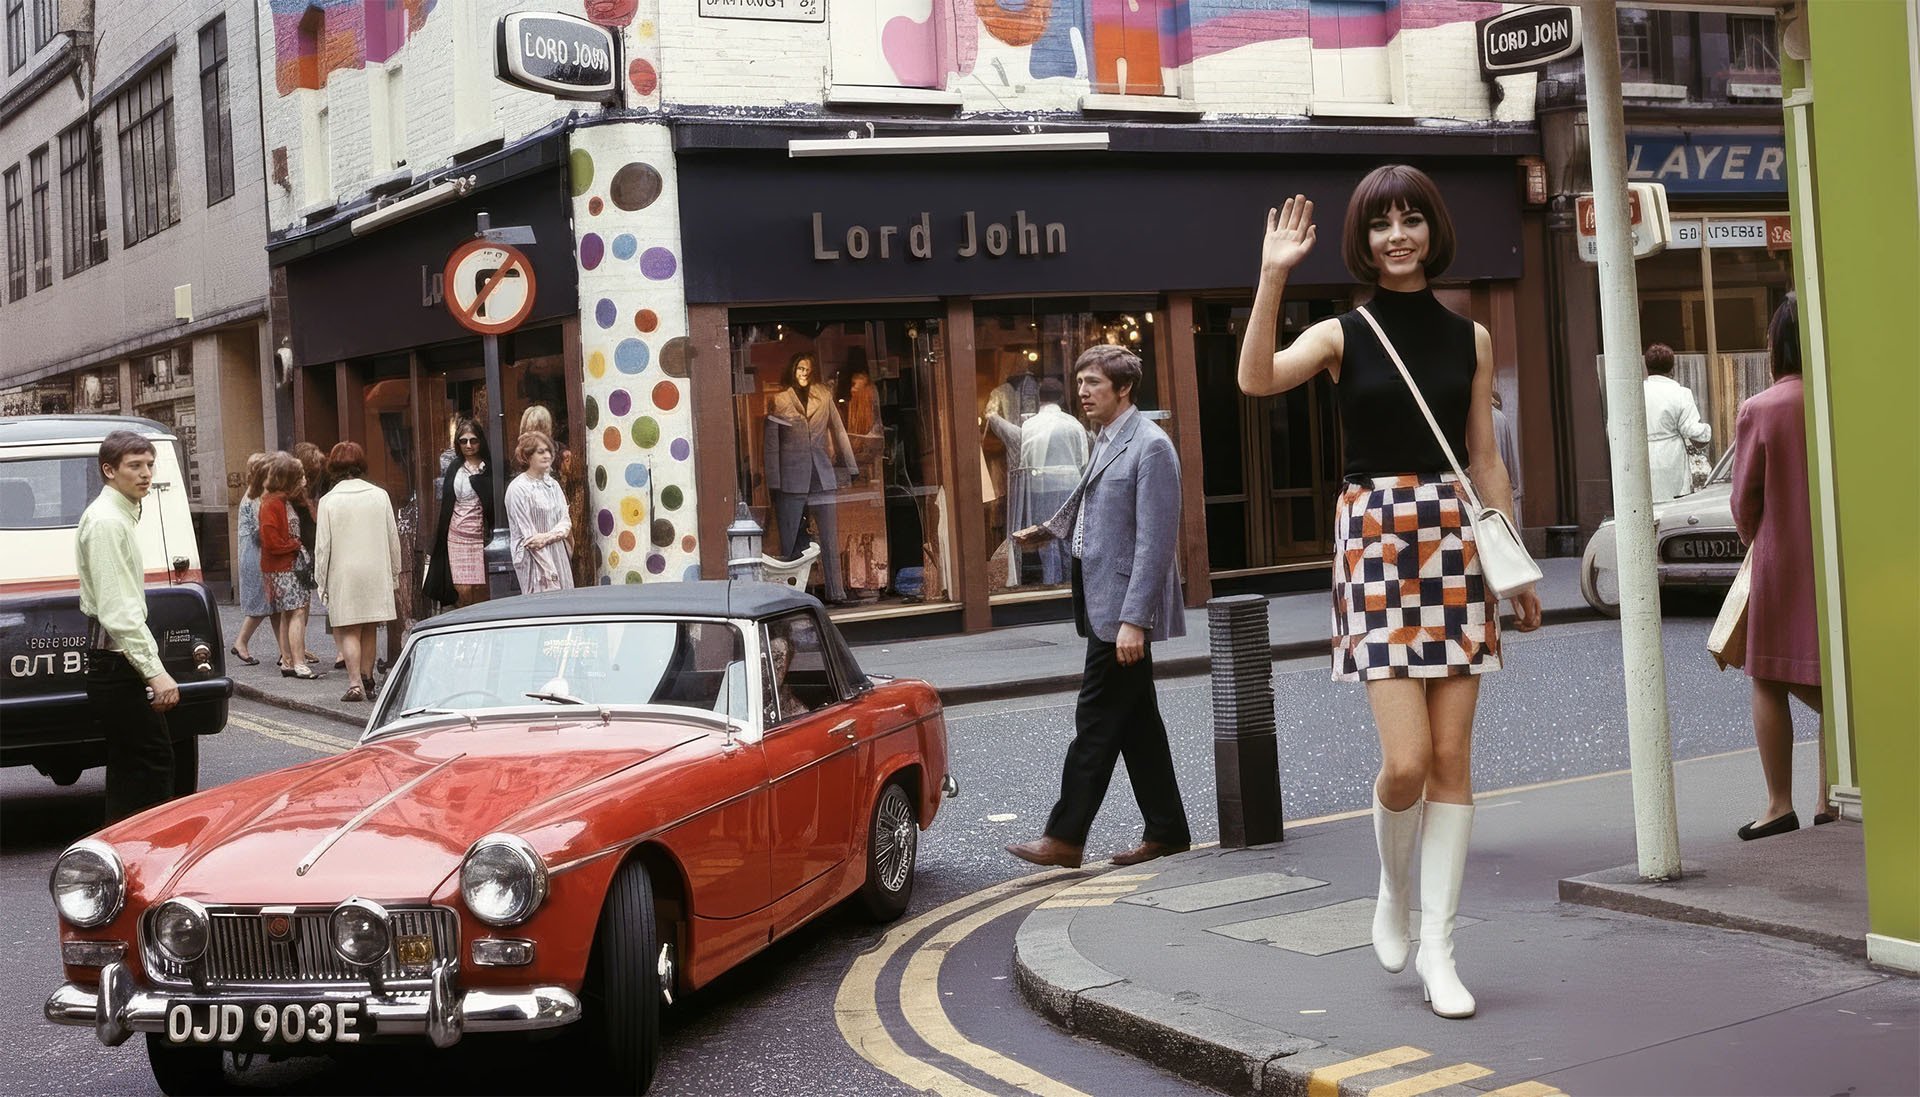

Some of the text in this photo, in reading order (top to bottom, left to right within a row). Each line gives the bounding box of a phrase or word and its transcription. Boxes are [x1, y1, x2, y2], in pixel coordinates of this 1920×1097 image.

[1490, 19, 1568, 55] LORD JOHN
[812, 210, 1067, 260] Lord John
[422, 265, 444, 307] Lo
[168, 1002, 360, 1043] OJD 903E
